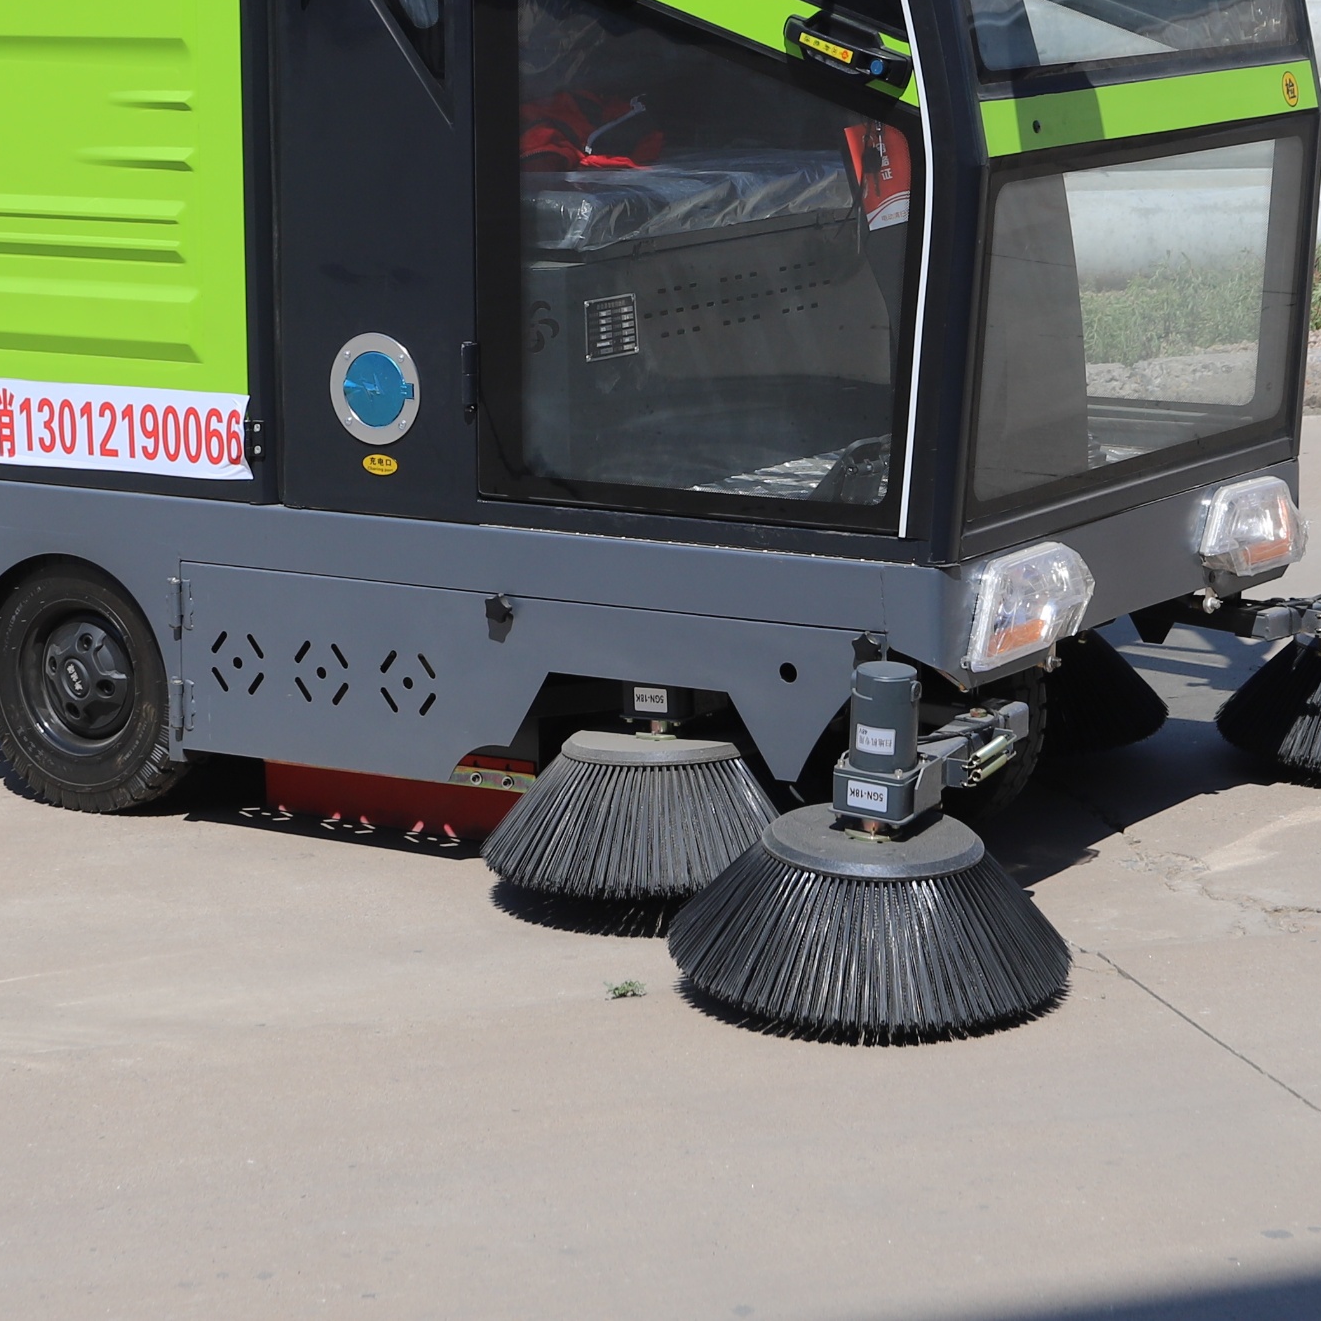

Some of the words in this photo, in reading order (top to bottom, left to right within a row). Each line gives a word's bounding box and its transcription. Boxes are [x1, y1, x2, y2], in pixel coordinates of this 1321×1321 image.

[369, 457, 392, 467] 充电口
[635, 693, 665, 704] 5GN-18K
[849, 787, 884, 803] 5GN-18K
